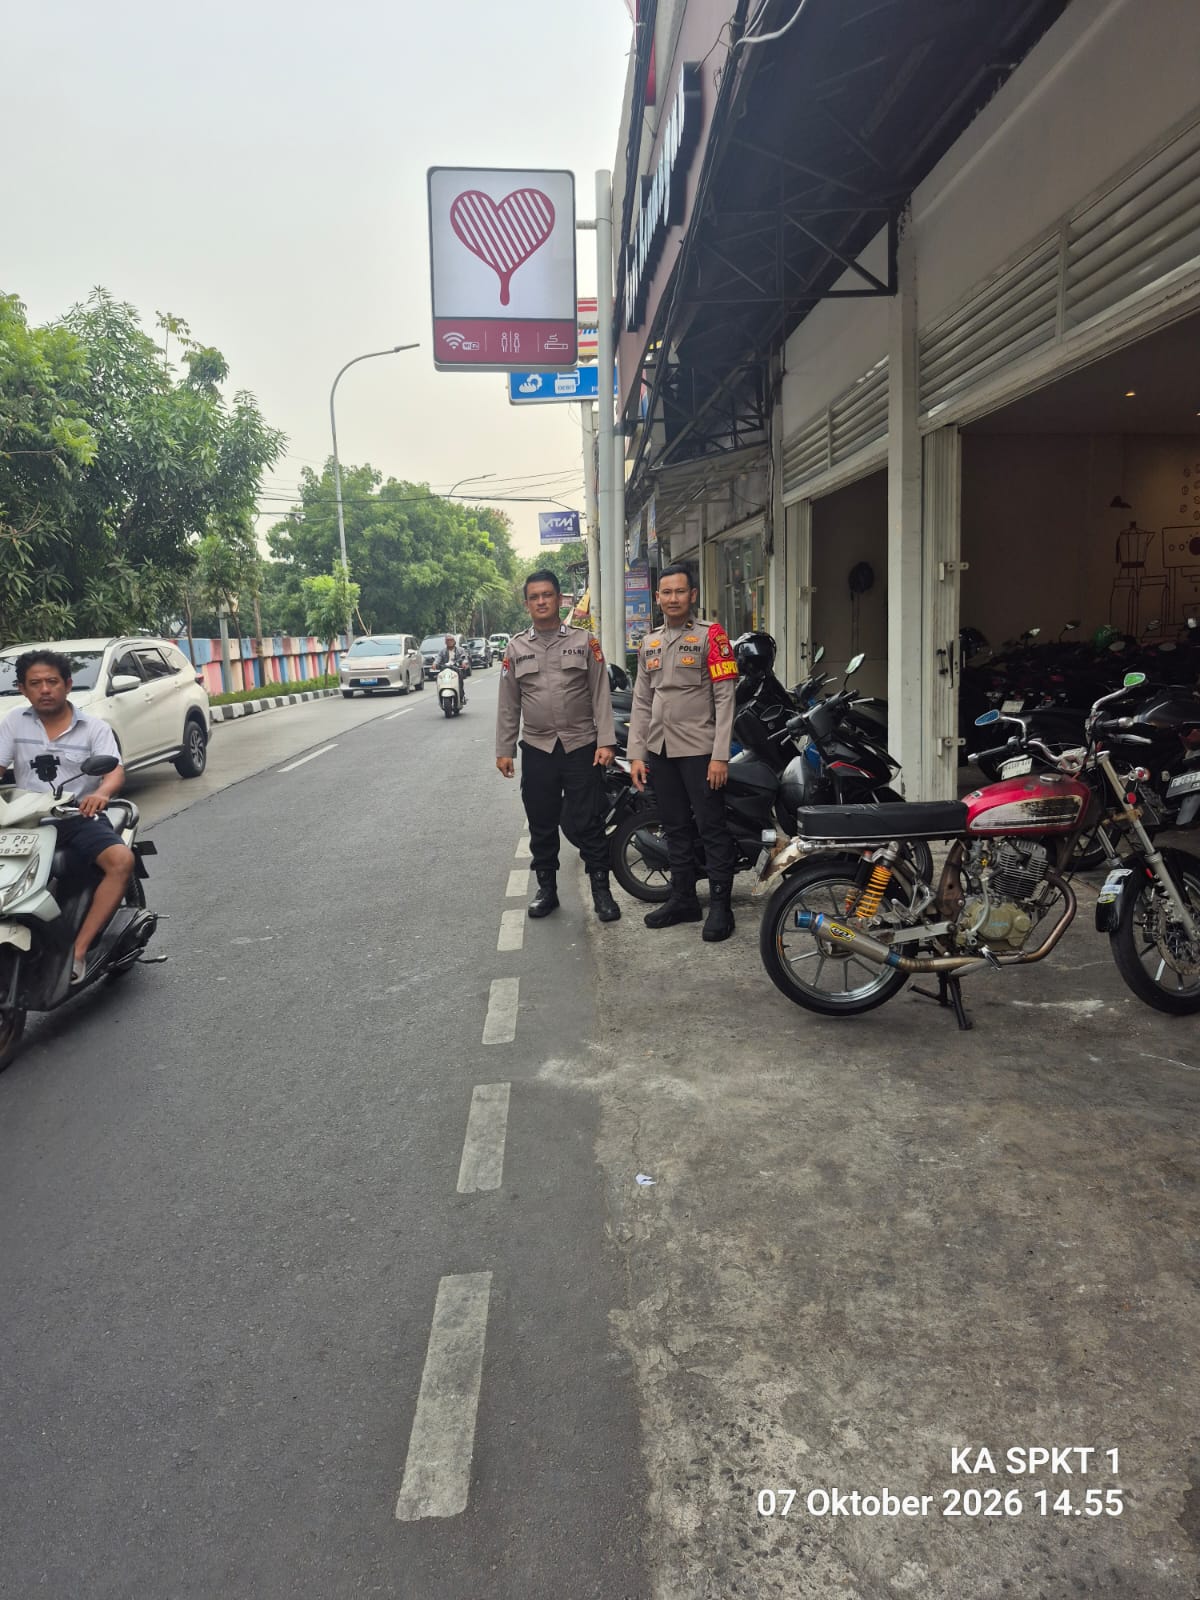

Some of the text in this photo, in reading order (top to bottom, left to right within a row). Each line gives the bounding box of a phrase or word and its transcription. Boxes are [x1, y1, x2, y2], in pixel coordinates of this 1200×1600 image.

[679, 645, 701, 653] POLRI
[709, 663, 722, 679] KA
[13, 835, 36, 844] PRJ
